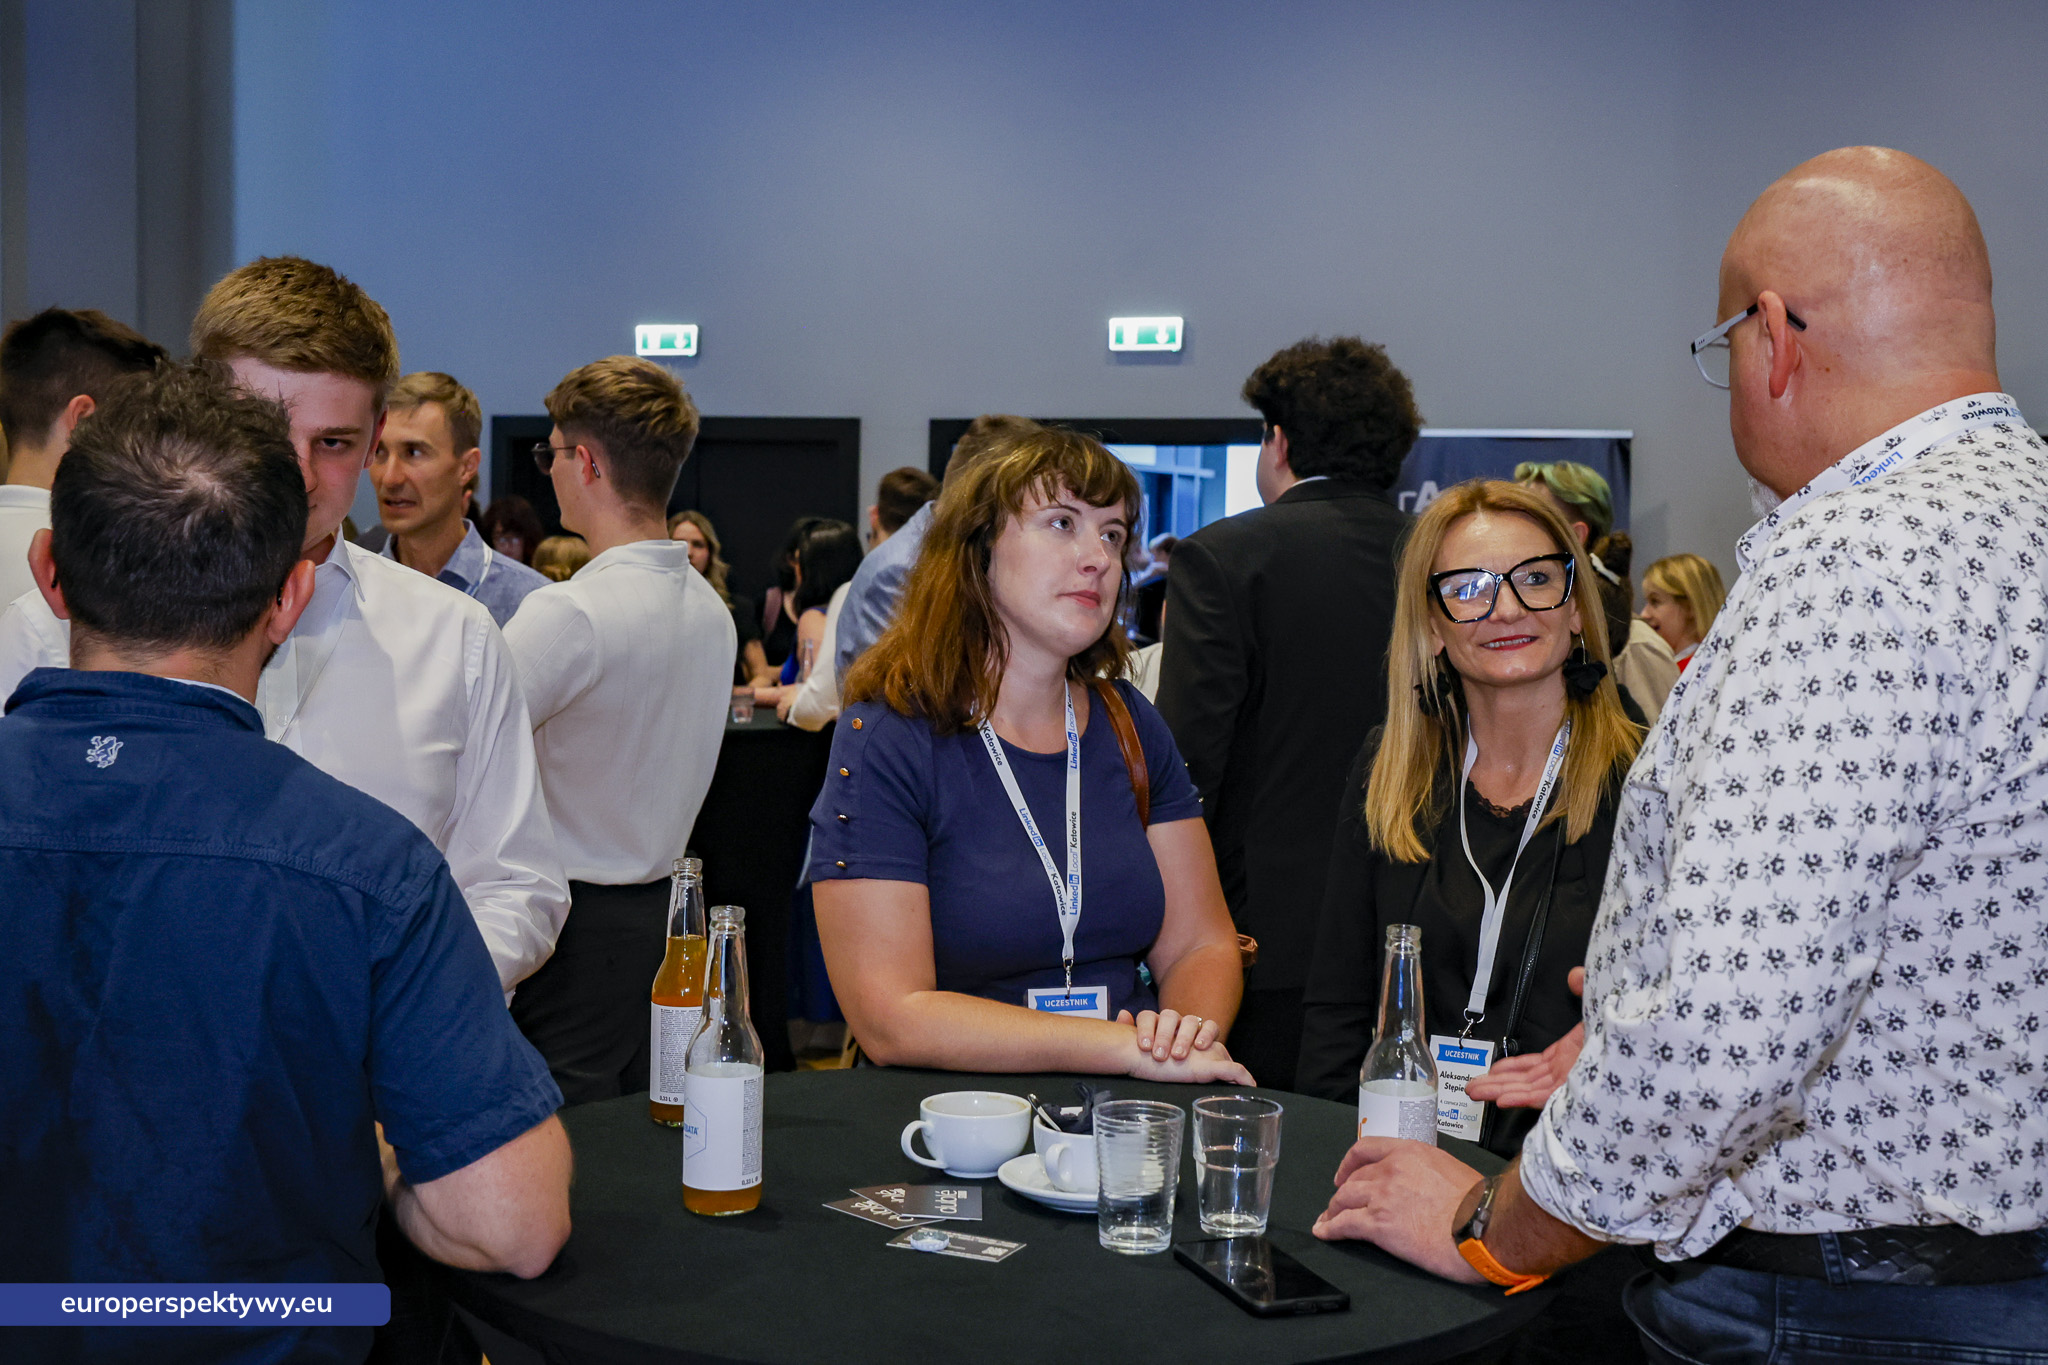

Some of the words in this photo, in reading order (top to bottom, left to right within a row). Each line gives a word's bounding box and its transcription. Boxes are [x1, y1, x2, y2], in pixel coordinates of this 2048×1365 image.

[1961, 405, 2011, 421] Katowice
[982, 726, 1003, 766] Katowice
[1531, 780, 1551, 819] Katowice
[1069, 811, 1077, 848] Katowice
[1051, 873, 1066, 916] Katowice
[1044, 998, 1089, 1007] UCZESTNIK
[1445, 1050, 1480, 1060] UCZESTNIK
[1440, 1071, 1473, 1082] Aleksandr
[1444, 1082, 1465, 1092] Stępie
[1460, 1112, 1478, 1122] Local
[1437, 1119, 1464, 1129] Katowice
